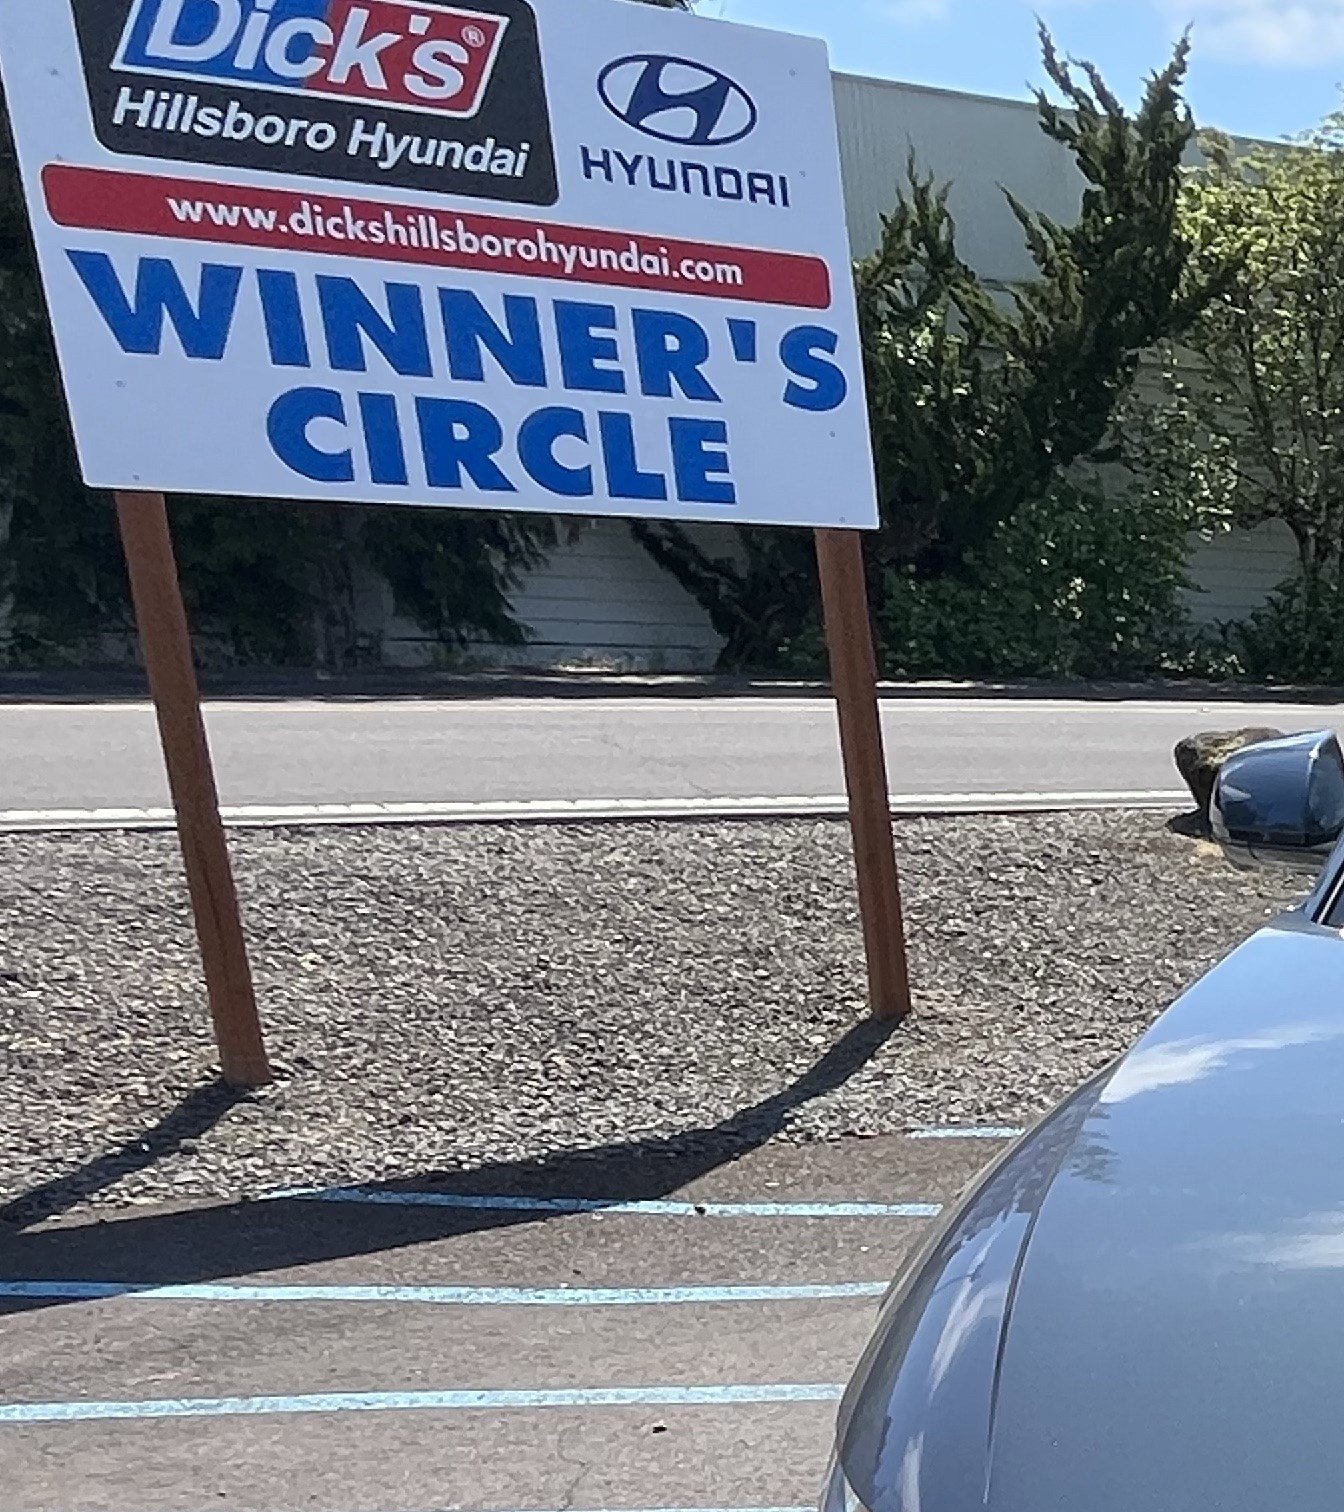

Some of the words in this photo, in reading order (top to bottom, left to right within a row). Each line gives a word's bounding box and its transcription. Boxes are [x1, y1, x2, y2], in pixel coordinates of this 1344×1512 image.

[144, 0, 470, 99] Dick's
[112, 86, 337, 152] Hillsboro
[347, 118, 531, 179] Hyundai
[579, 145, 790, 207] HYUNDAI
[167, 191, 744, 287] www.dickshillsborohyundai.com
[64, 248, 848, 411] WINNER'S
[266, 386, 737, 504] CIRCLE
